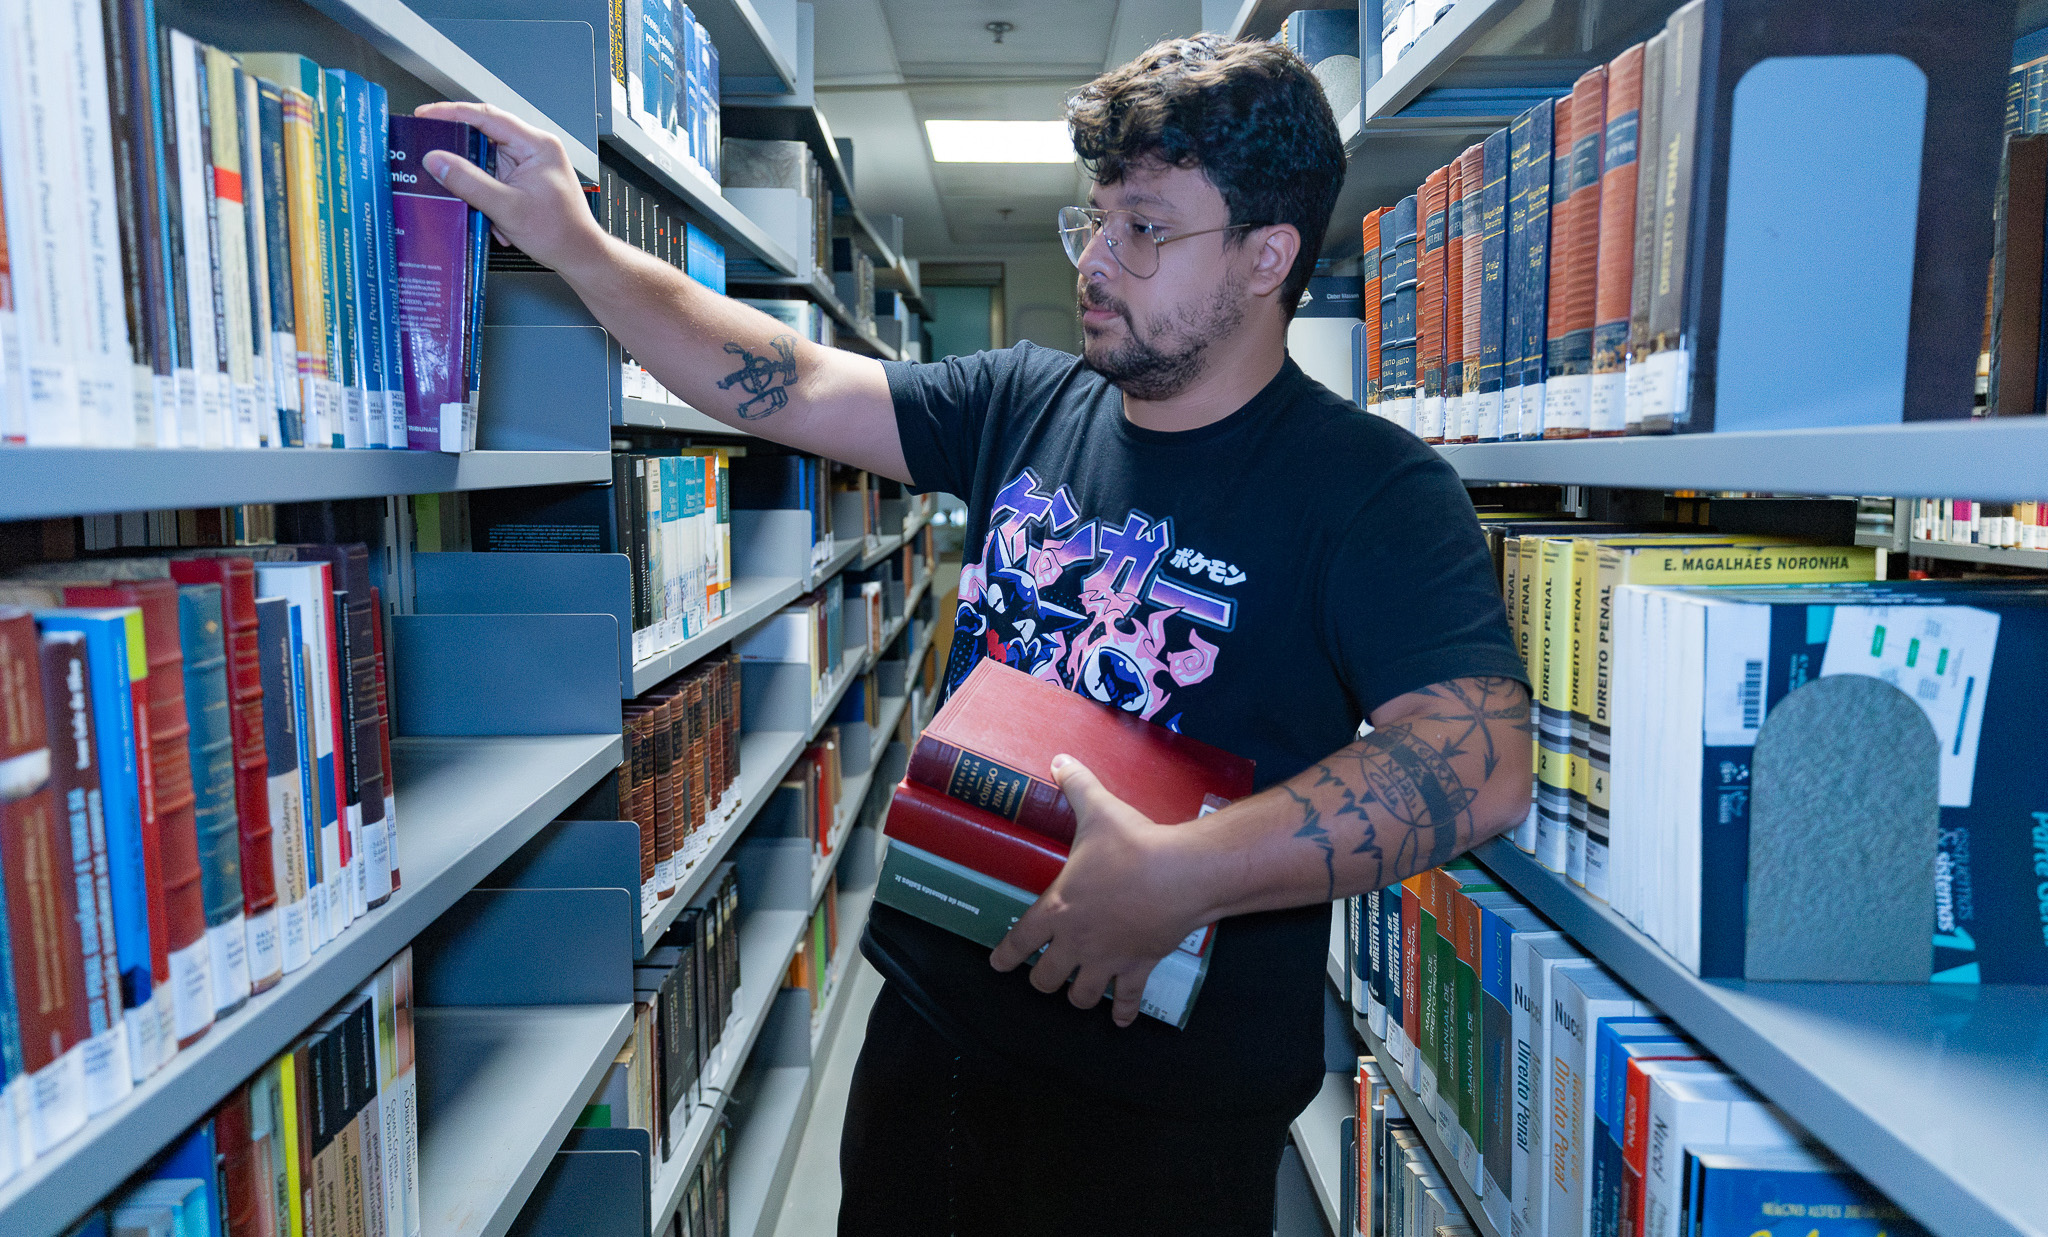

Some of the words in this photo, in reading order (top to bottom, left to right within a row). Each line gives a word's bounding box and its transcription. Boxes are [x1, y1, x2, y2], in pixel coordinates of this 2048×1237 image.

[1665, 132, 1681, 207] PENAL
[362, 202, 377, 279] Econômico
[1659, 212, 1675, 296] DIREITO
[1486, 270, 1498, 282] Penal
[368, 283, 379, 322] Penal
[1389, 320, 1394, 329] 4
[1406, 312, 1410, 321] 4
[371, 326, 381, 373] Direito
[1170, 548, 1247, 586] ポケモン
[1664, 558, 1677, 571] E.
[1682, 554, 1772, 571] MAGALHÃES
[1777, 556, 1850, 570] NORONHA
[1508, 569, 1516, 621] PENAL
[1521, 574, 1530, 626] PENAL
[1544, 577, 1552, 632] PENAL
[1574, 577, 1582, 634] PENAL
[1600, 585, 1611, 644] PENAL
[342, 602, 352, 647] Brasileiro
[344, 648, 354, 694] Tributário
[1520, 632, 1529, 671] EITO
[1542, 637, 1550, 702] DIREITO
[1571, 639, 1580, 706] DIREITO
[347, 695, 355, 720] Penal
[1597, 650, 1609, 720] DIREITO
[348, 722, 357, 753] Direito
[351, 753, 358, 765] de
[351, 767, 359, 793] Curso
[1541, 754, 1547, 770] 2
[1571, 761, 1576, 777] 3
[979, 767, 998, 806] CÓDIGO
[992, 780, 1008, 808] PENAL
[1595, 777, 1602, 793] 4
[946, 895, 957, 906] de
[1372, 890, 1380, 925] PENAL
[1935, 851, 1956, 932] sistemas
[1387, 914, 1393, 931] DE
[1407, 928, 1412, 945] DE
[1372, 927, 1380, 973] DIREITO
[1428, 954, 1433, 973] DE
[1393, 950, 1401, 998] DIREITO
[1444, 983, 1450, 1002] DE
[1425, 976, 1433, 1031] MANUAL
[1467, 1012, 1474, 1032] DE
[1514, 983, 1542, 1026] Nucci
[1554, 999, 1584, 1046] Nucci
[1517, 1039, 1531, 1101] Direito
[1554, 1056, 1570, 1129] Direito
[404, 1098, 412, 1138] ORDEM
[1516, 1101, 1530, 1154] Penal
[1571, 1072, 1583, 1150] Manual
[1626, 1094, 1636, 1147] NUCCI
[386, 1114, 395, 1154] ORDEM
[1651, 1115, 1669, 1183] Nucci
[387, 1155, 397, 1211] TRIBUTÁRIA
[405, 1139, 413, 1195] TRIBUTÁRIA
[1553, 1130, 1569, 1194] Penal
